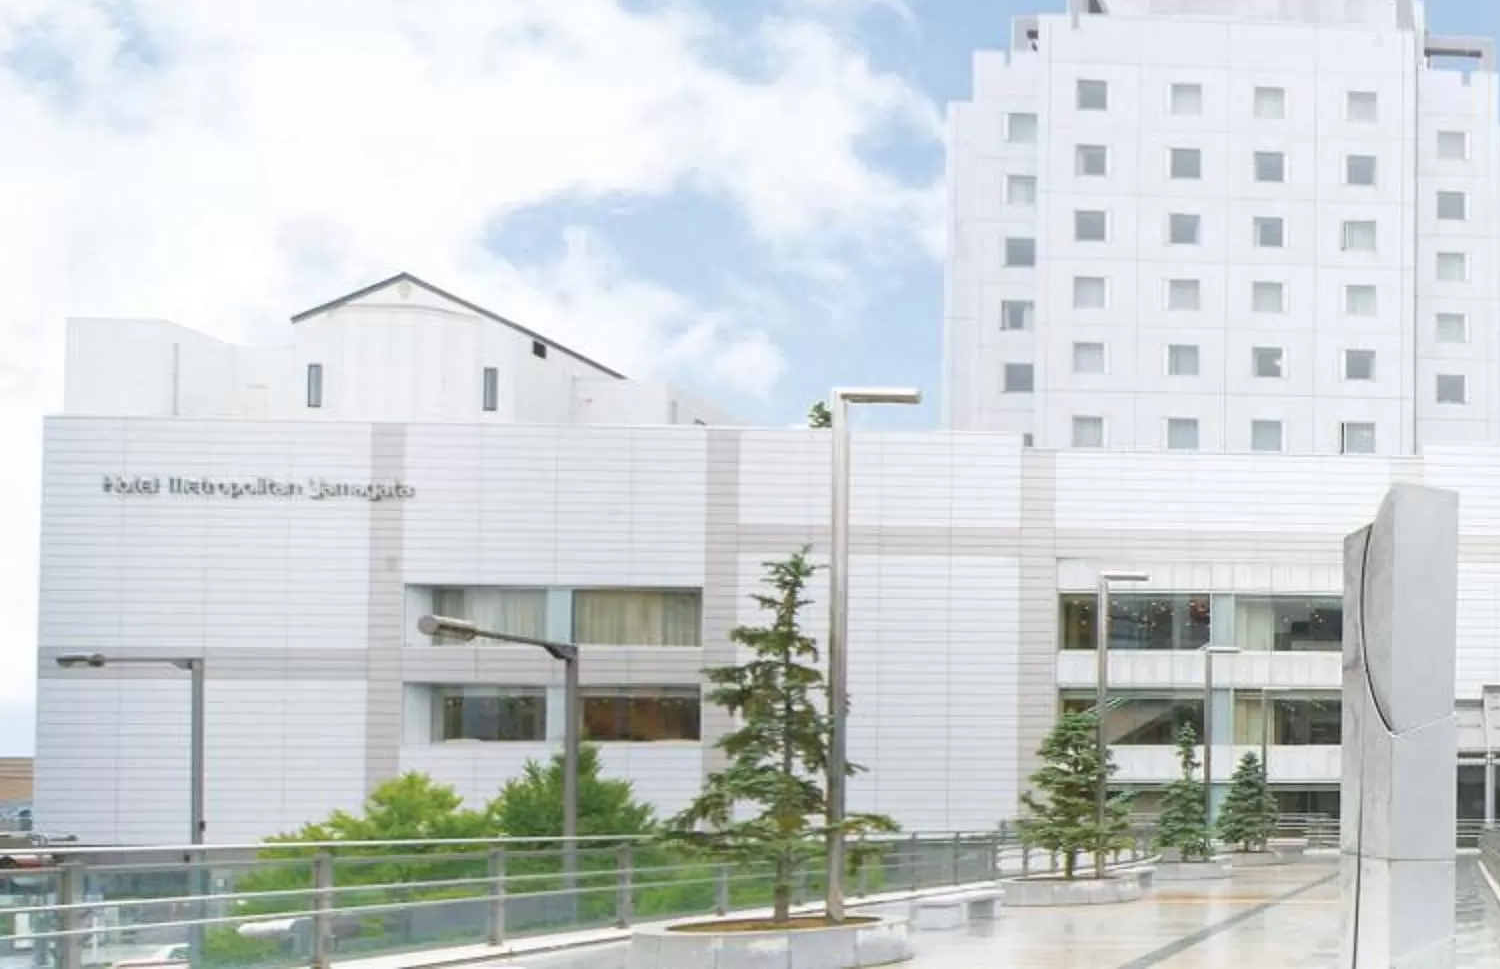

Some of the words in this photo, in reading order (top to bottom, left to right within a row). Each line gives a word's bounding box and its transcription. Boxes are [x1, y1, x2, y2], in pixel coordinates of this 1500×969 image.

[101, 475, 161, 495] Hotel
[168, 477, 304, 499] Metropolitan
[308, 477, 416, 502] Yamagata
